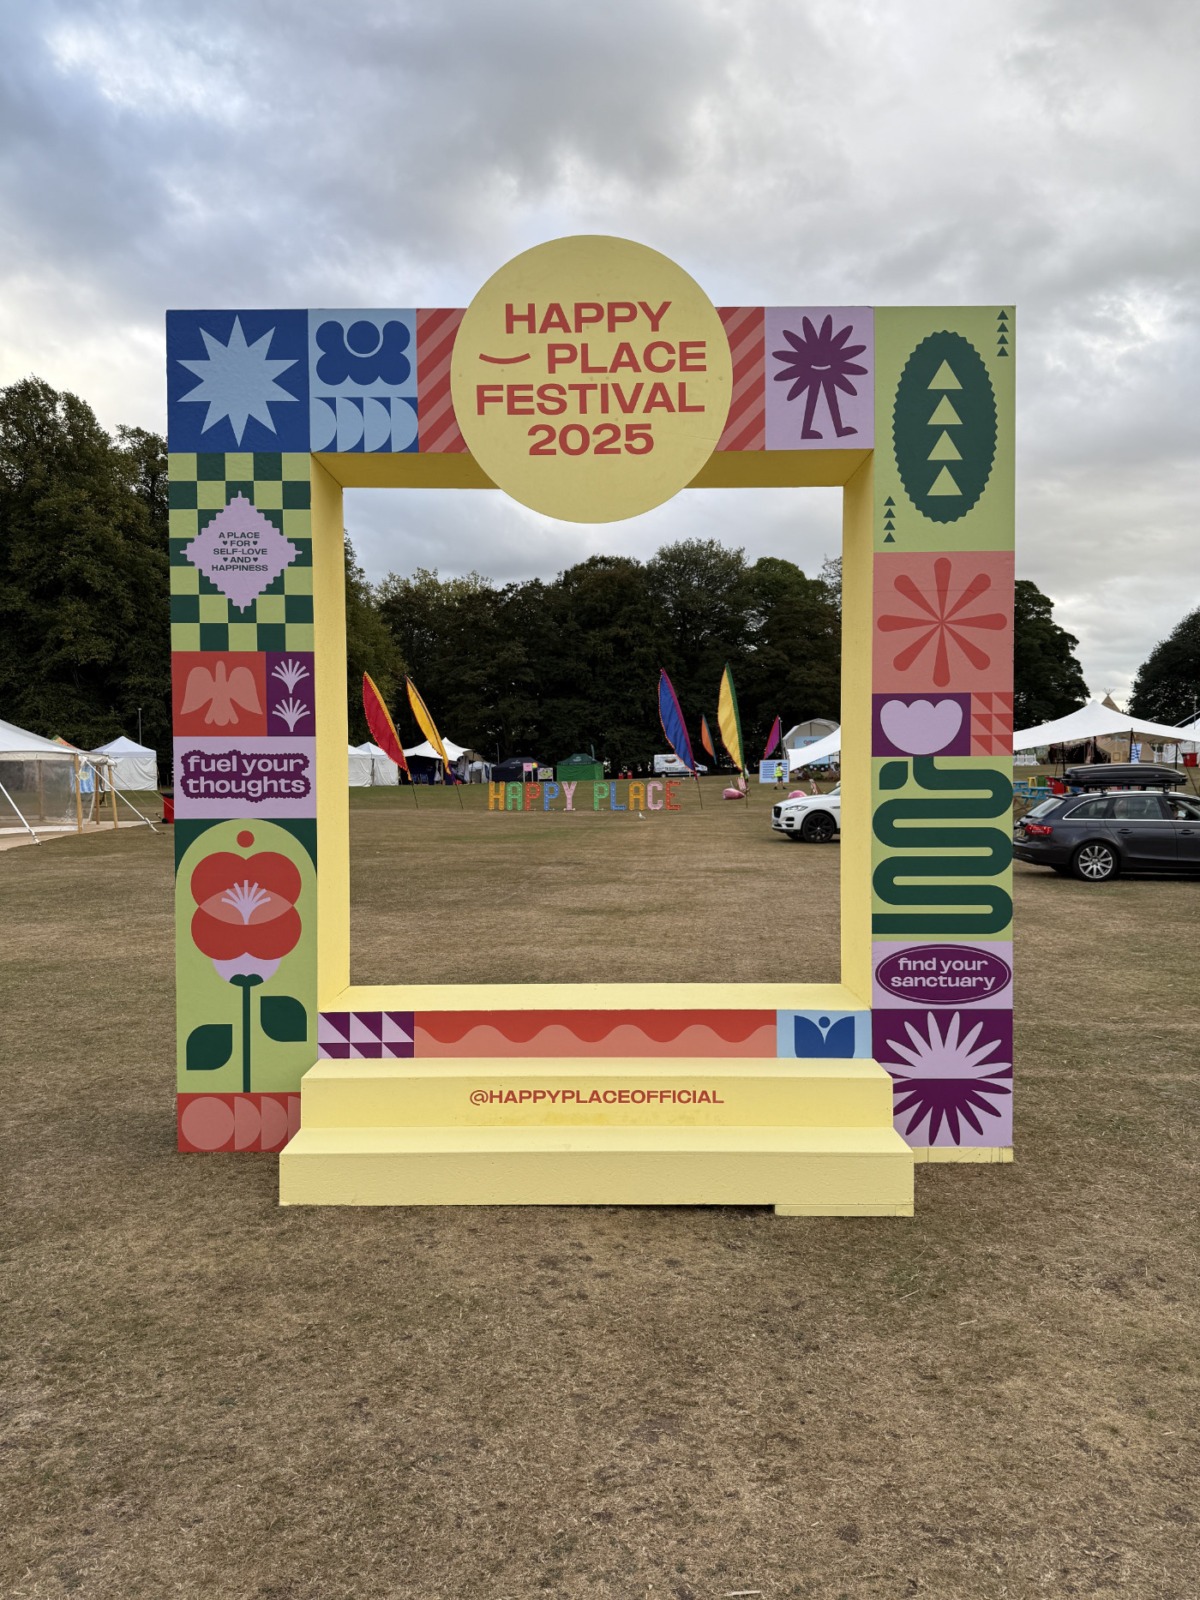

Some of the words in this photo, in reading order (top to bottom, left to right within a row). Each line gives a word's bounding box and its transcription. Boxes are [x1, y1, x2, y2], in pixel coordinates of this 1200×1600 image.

[505, 301, 672, 334] HAPPY
[547, 341, 707, 374] PLACE
[476, 382, 705, 415] FESTIVAL
[527, 423, 654, 456] 2025
[188, 755, 238, 772] fuel
[241, 758, 304, 776] your
[187, 776, 305, 797] thoughts
[488, 781, 578, 811] HAPPY
[593, 780, 681, 811] PLACE
[898, 957, 937, 971] find
[940, 960, 989, 974] your
[890, 975, 996, 990] sanctuary
[469, 1089, 724, 1106] @HAPPYPLACEOFFICIAL
